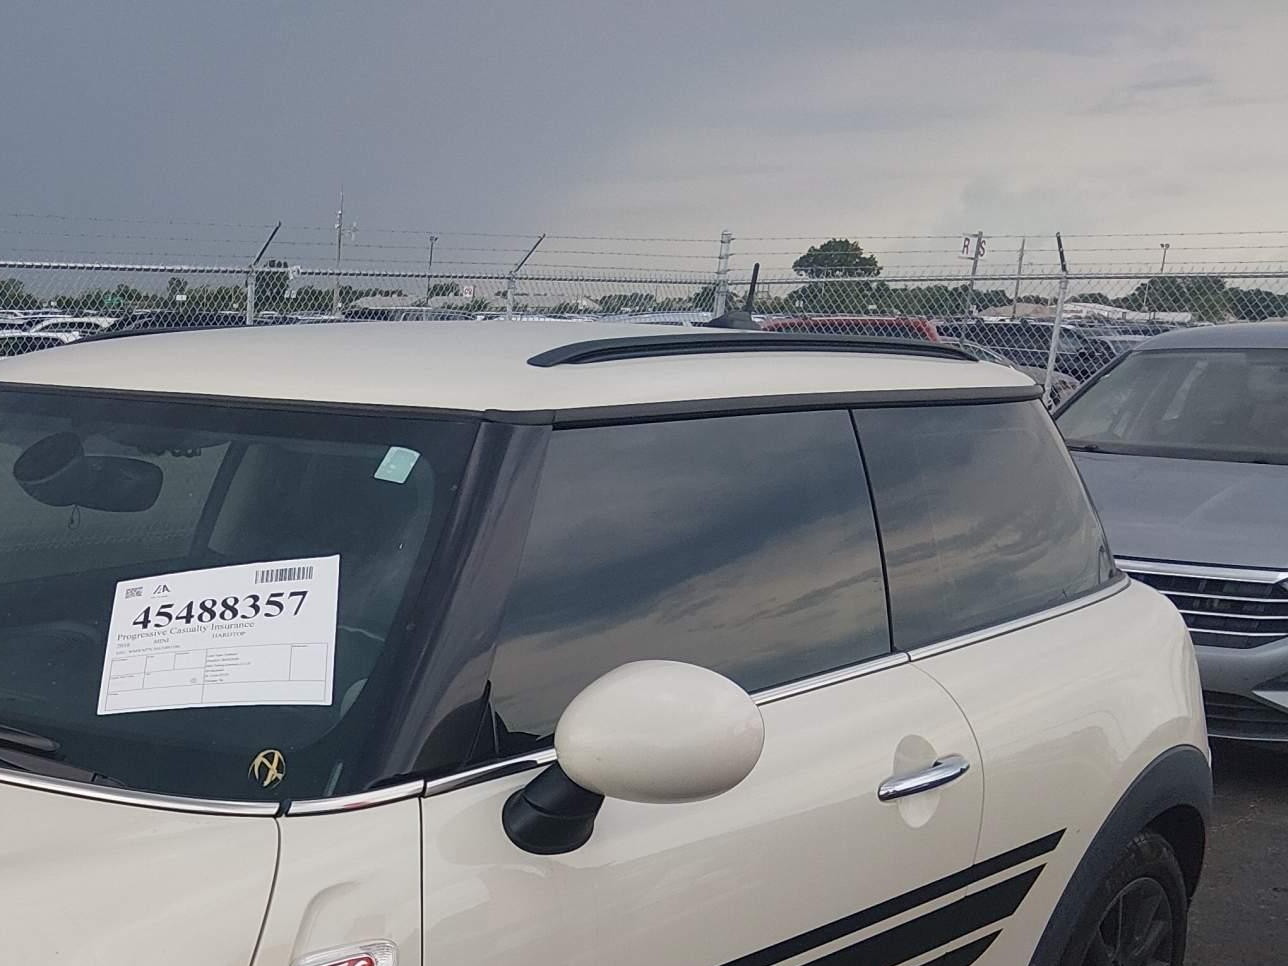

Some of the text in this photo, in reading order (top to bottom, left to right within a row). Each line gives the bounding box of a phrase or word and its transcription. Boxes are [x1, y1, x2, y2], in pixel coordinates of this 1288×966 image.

[961, 237, 986, 257] R S
[132, 590, 309, 630] 45488357
[117, 621, 256, 642] Progressive Casualty Insurance
